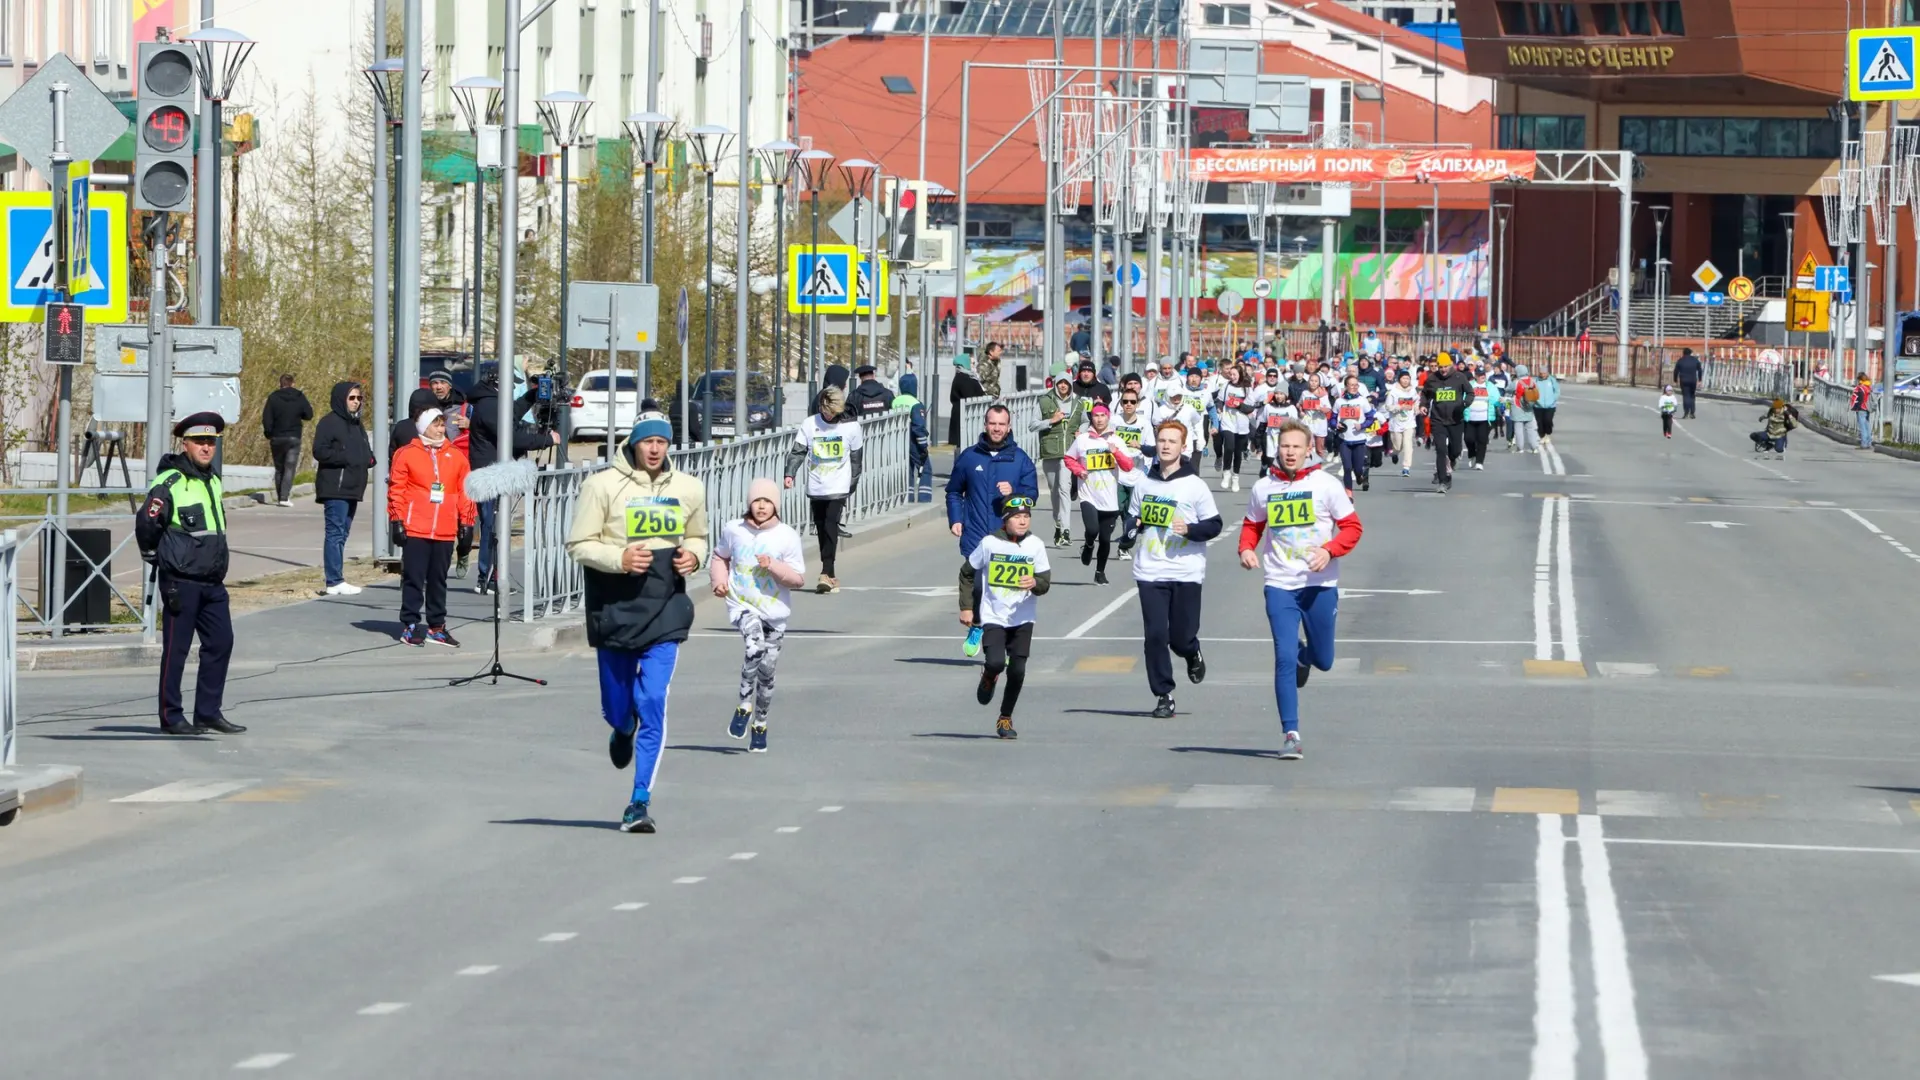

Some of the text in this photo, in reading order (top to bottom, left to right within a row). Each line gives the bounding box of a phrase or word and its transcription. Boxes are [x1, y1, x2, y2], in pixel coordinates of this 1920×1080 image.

[151, 112, 184, 143] 49
[1195, 155, 1508, 174] БЕССМЕРТНЫЙ ПОЛК САЛЕХАРД
[1438, 391, 1454, 400] 223
[1344, 409, 1356, 418] 50
[1091, 455, 1113, 468] 174
[633, 508, 678, 534] 256
[1144, 504, 1170, 524] 259
[1273, 501, 1310, 524] 214
